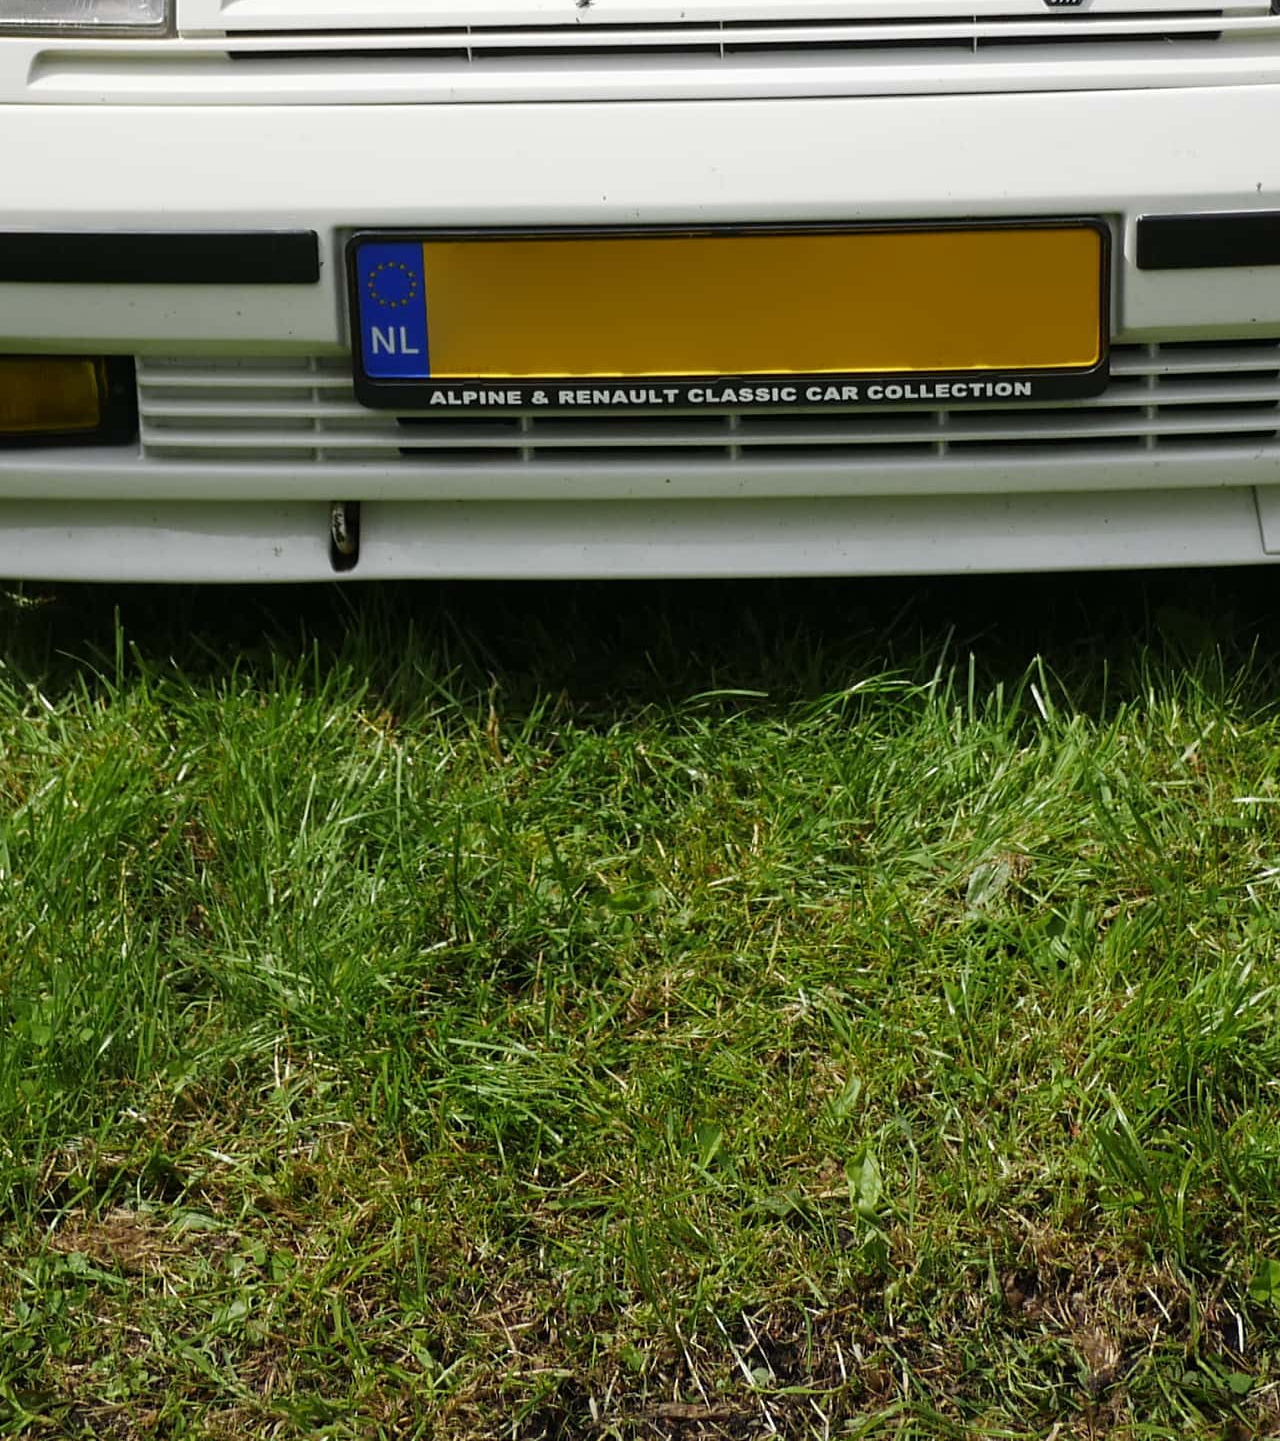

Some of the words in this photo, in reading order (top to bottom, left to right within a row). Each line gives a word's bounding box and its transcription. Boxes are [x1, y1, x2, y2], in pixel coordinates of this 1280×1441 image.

[371, 326, 419, 354] NL
[429, 390, 523, 405] ALPINE
[531, 390, 549, 405] &
[558, 389, 679, 404] RENAULT
[687, 387, 797, 403] CLASSIC
[805, 386, 859, 401] CAR
[866, 382, 1032, 400] COLLECTION
